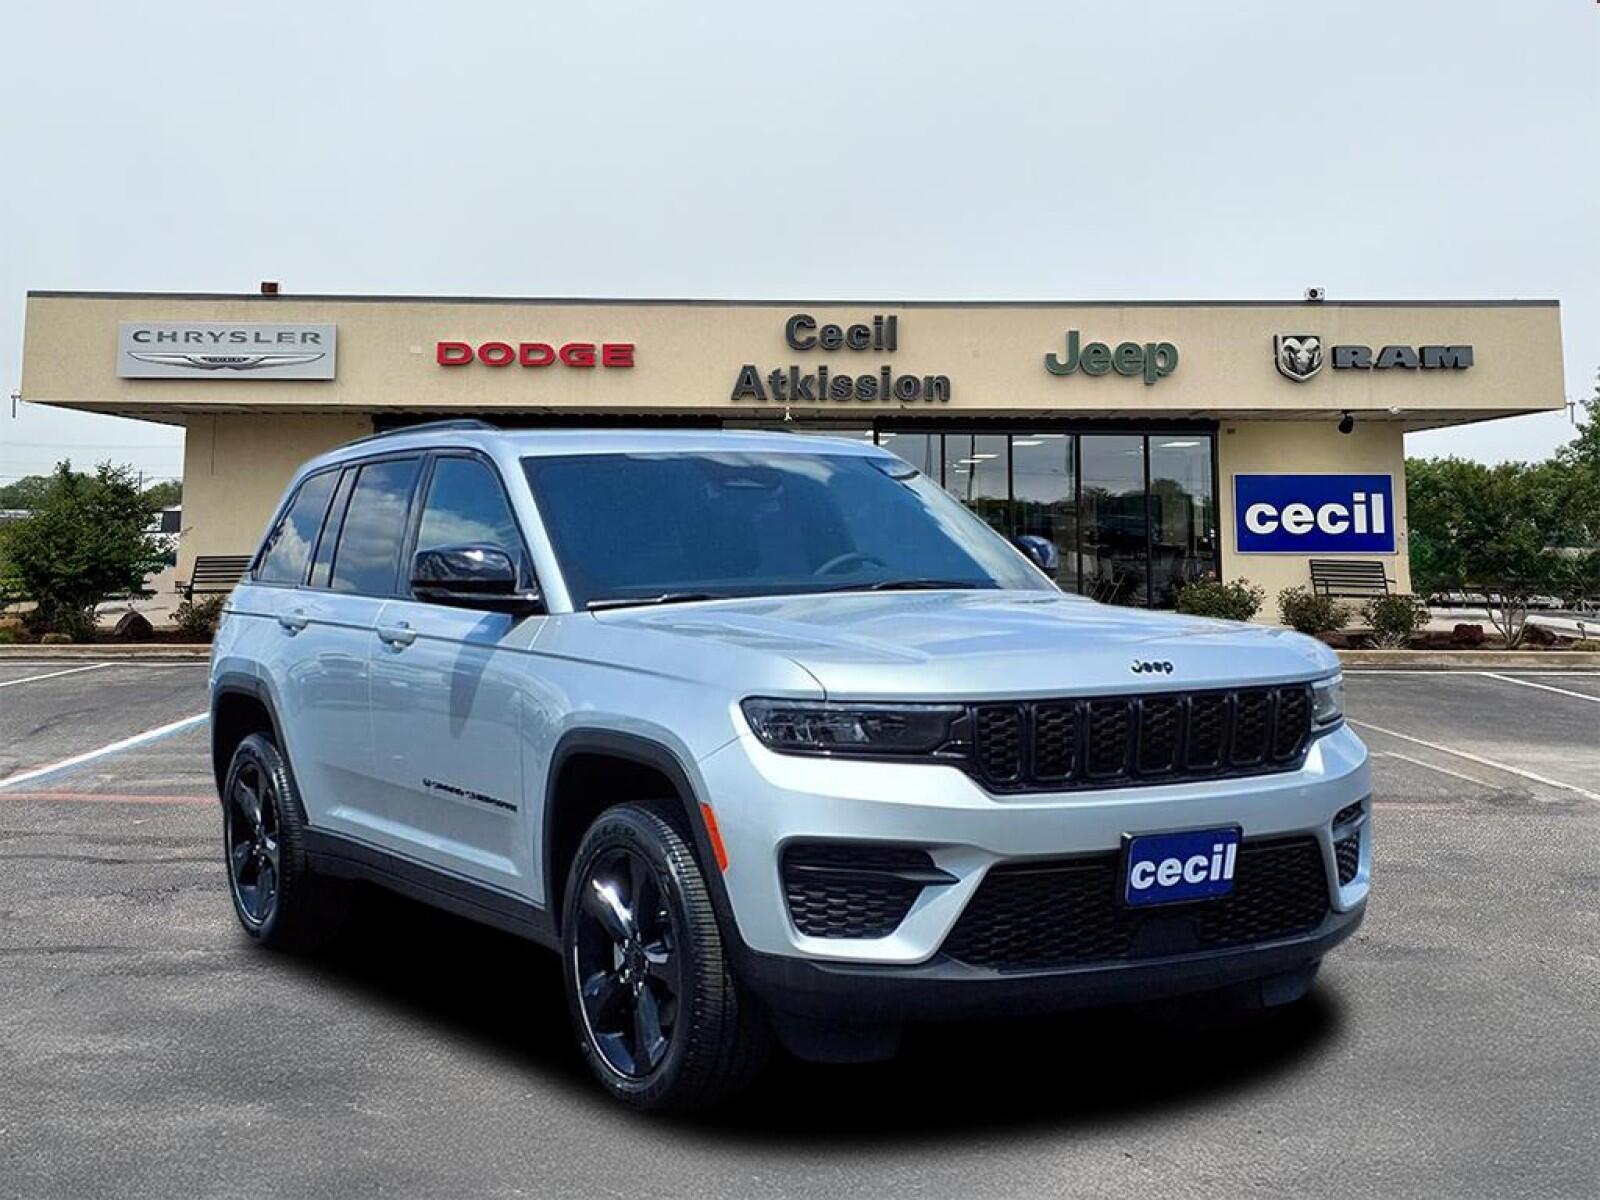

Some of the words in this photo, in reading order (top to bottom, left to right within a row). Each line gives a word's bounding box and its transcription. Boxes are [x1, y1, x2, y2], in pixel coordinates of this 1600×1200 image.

[132, 330, 321, 345] CHRYSLER
[785, 314, 898, 352] Cecil
[437, 341, 635, 368] DODGE
[1045, 330, 1179, 386] Jeep
[1331, 345, 1474, 370] RAM
[732, 364, 951, 402] Atkission
[1245, 491, 1385, 534] cecil
[1131, 659, 1174, 675] Jeep
[1130, 843, 1237, 890] cecil
